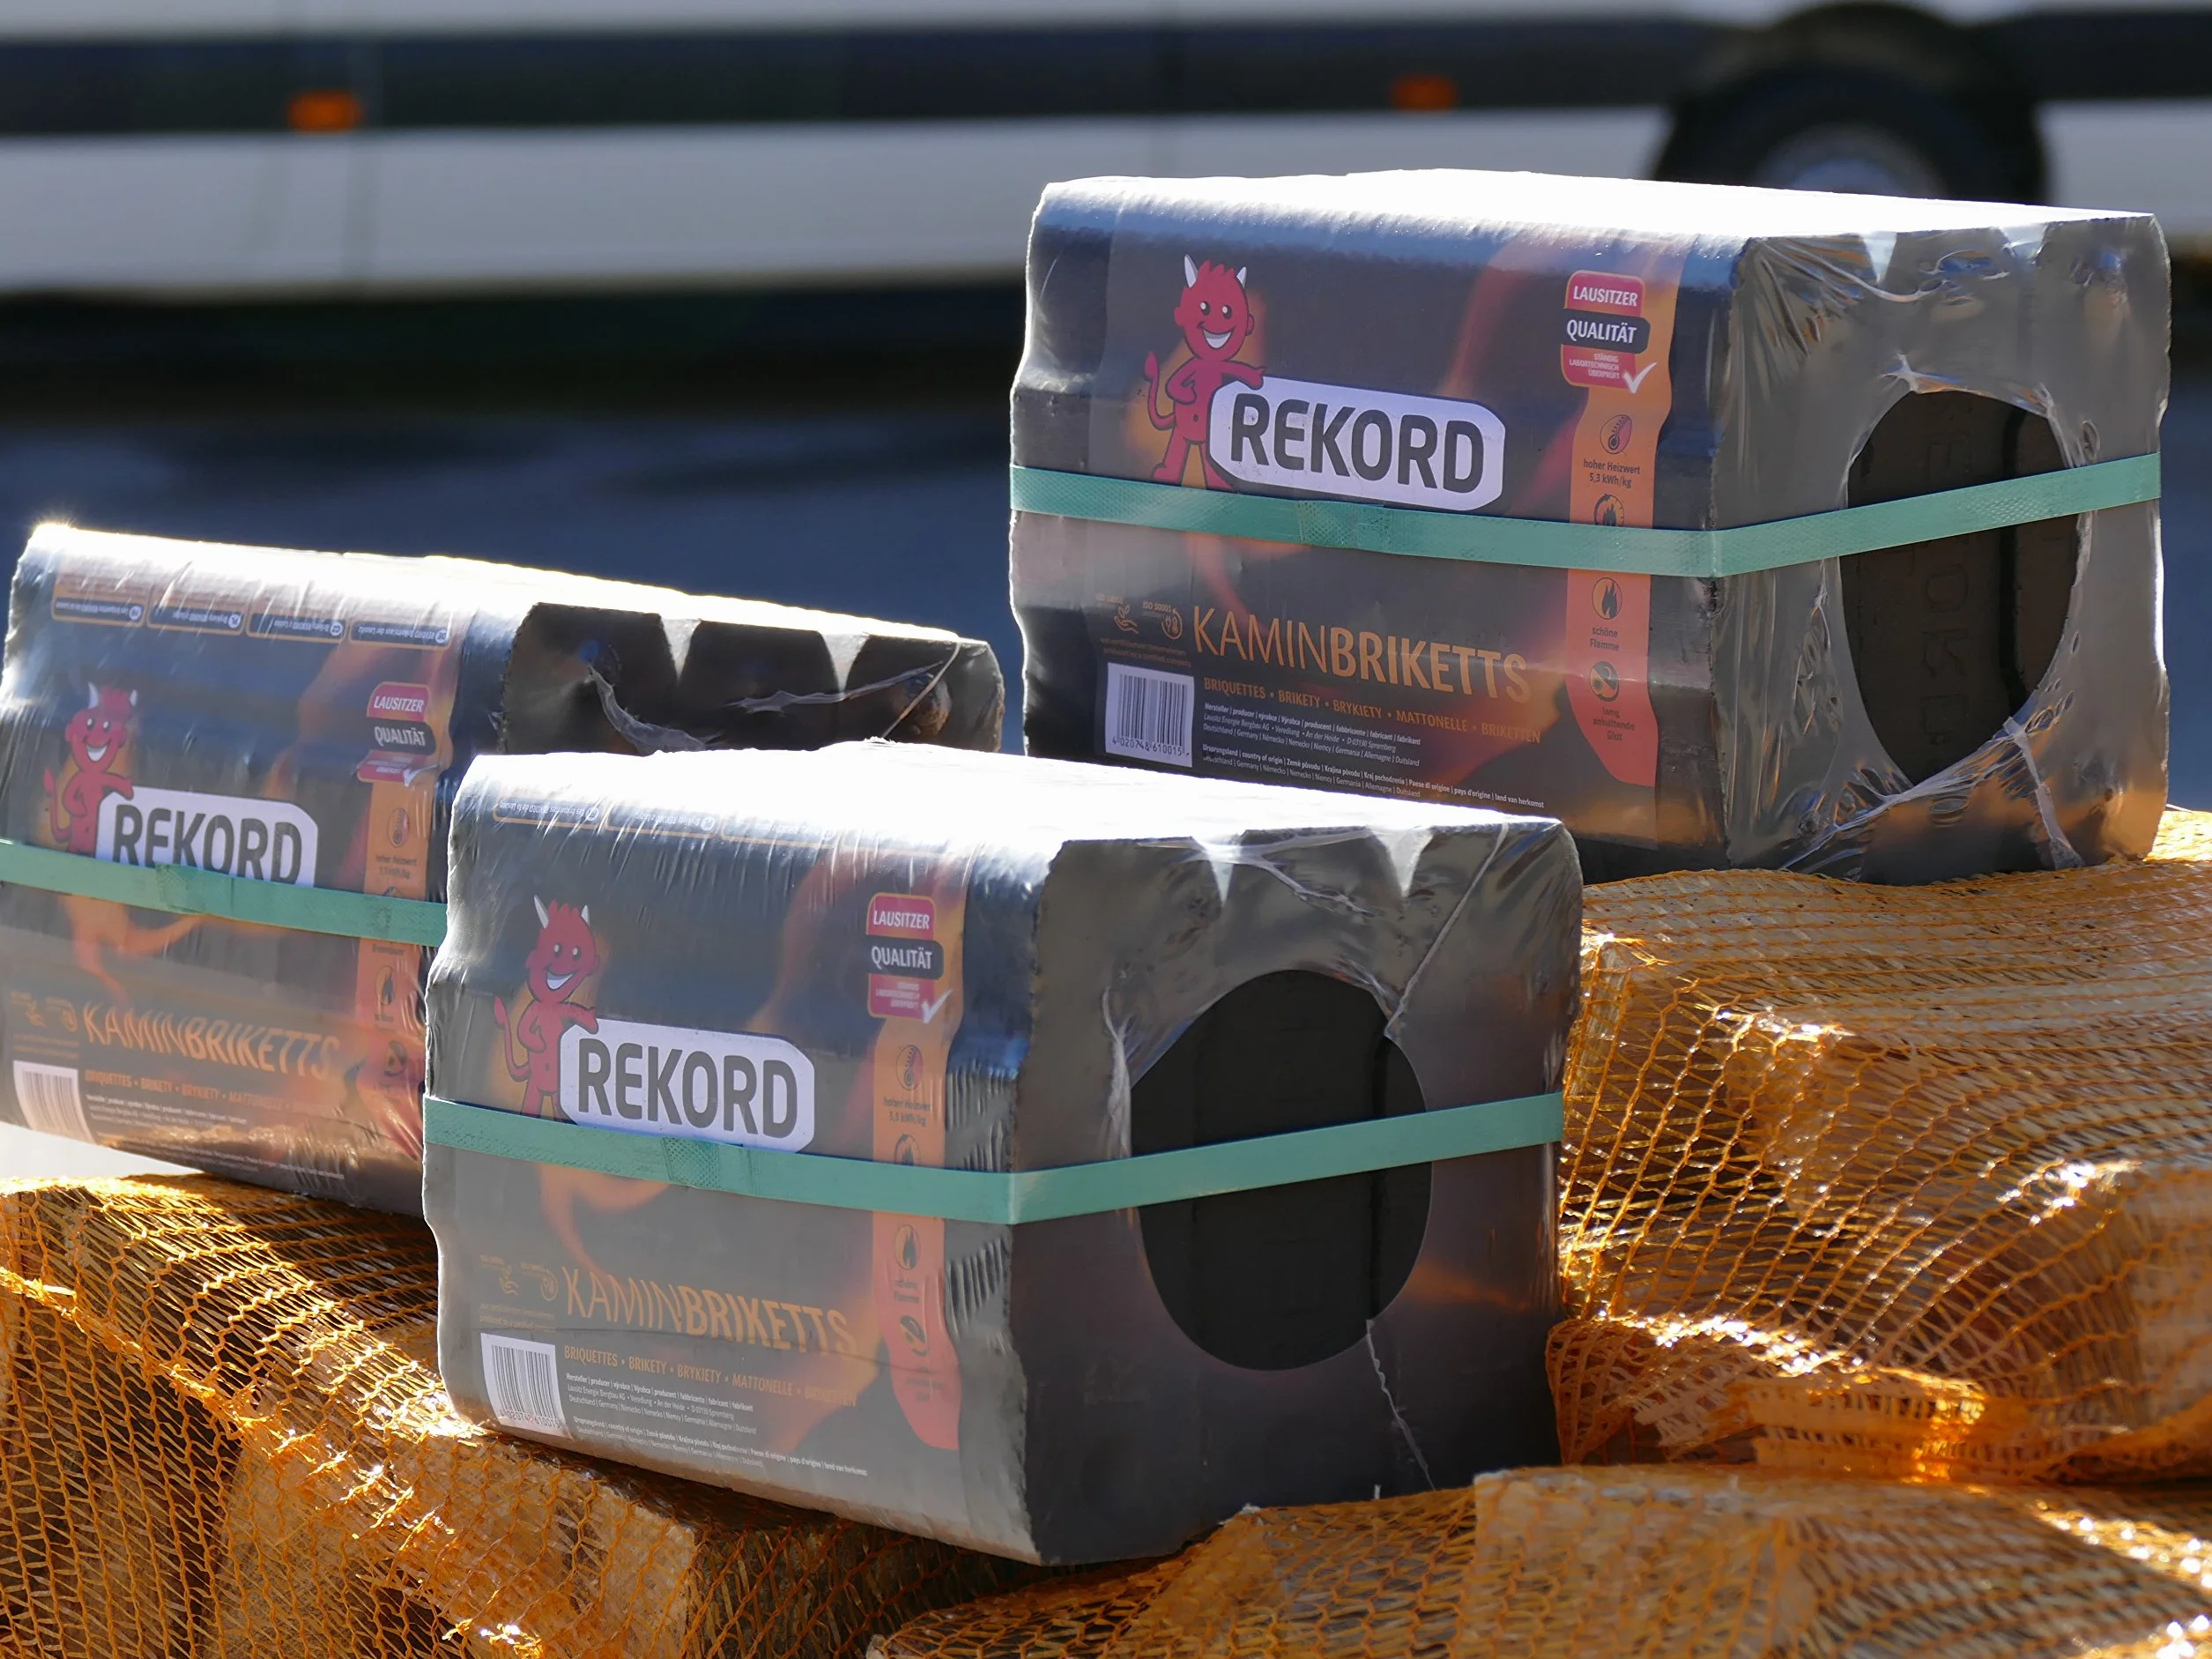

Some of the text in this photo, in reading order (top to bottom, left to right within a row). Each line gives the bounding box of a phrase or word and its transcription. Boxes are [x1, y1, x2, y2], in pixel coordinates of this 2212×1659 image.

[1572, 285, 1638, 307] LAUSITZER
[1566, 318, 1637, 344] QUALITÄT
[1231, 392, 1485, 495] REKORD
[1583, 458, 1641, 475] hoher Heizwert
[1589, 472, 1632, 489] 5,3 kWh/kg
[1589, 638, 1620, 651] Flamme
[1592, 626, 1619, 638] schöne
[1193, 605, 1532, 704] KAMINBRIKETTS
[373, 696, 425, 713] LAUSITZER
[1203, 676, 1541, 745] BRIQUETTES BRIKETY BRYKIETY MATTONELLE BRIKETTEN
[1204, 703, 1229, 714] Hersteller
[1232, 708, 1255, 718] producer
[1304, 721, 1332, 732] producent
[1336, 725, 1365, 737] fabbricante
[1370, 731, 1392, 740] fabricant
[1397, 734, 1421, 745] fabrikant
[374, 725, 426, 747] QUALITÄT
[1203, 723, 1233, 735] Deutschland
[1236, 729, 1259, 741] Germany
[1313, 740, 1332, 754] Niemcy
[1335, 745, 1361, 757] Germania
[1364, 752, 1392, 763] Allemagne
[1396, 754, 1420, 767] Duitsland
[1204, 713, 1221, 723] Lausitz
[1241, 719, 1261, 731] Bergbau
[1275, 725, 1300, 738] Veredlung
[1313, 732, 1324, 740] der
[1324, 733, 1340, 743] Heide
[1368, 740, 1397, 754] Spremberg
[1242, 752, 1261, 763] country
[1267, 755, 1283, 766] origin
[1325, 765, 1342, 776] Krajina
[1409, 779, 1425, 789] Paese
[1431, 783, 1451, 793] origine
[1454, 787, 1467, 796] pays
[1468, 787, 1491, 800] d'origine
[1495, 793, 1507, 802] land
[1507, 796, 1518, 805] van
[1518, 797, 1545, 808] herkomst
[113, 804, 302, 884] REKORD
[872, 910, 931, 930] LAUSITZER
[871, 946, 933, 971] QUALITÄT
[83, 1001, 340, 1081] KAMINBRIKETTS
[85, 1068, 132, 1089] BRIQUETTES
[140, 1076, 174, 1093] BRIKETY
[182, 1082, 219, 1100] BRYKIETY
[578, 1038, 798, 1138] REKORD
[560, 1265, 858, 1358] KAMINBRIKETTS
[563, 1344, 618, 1368] BRIQUETTES
[628, 1356, 667, 1375] BRIKETY
[677, 1364, 723, 1385] BRYKIETY
[731, 1373, 793, 1397] MATTONELLE
